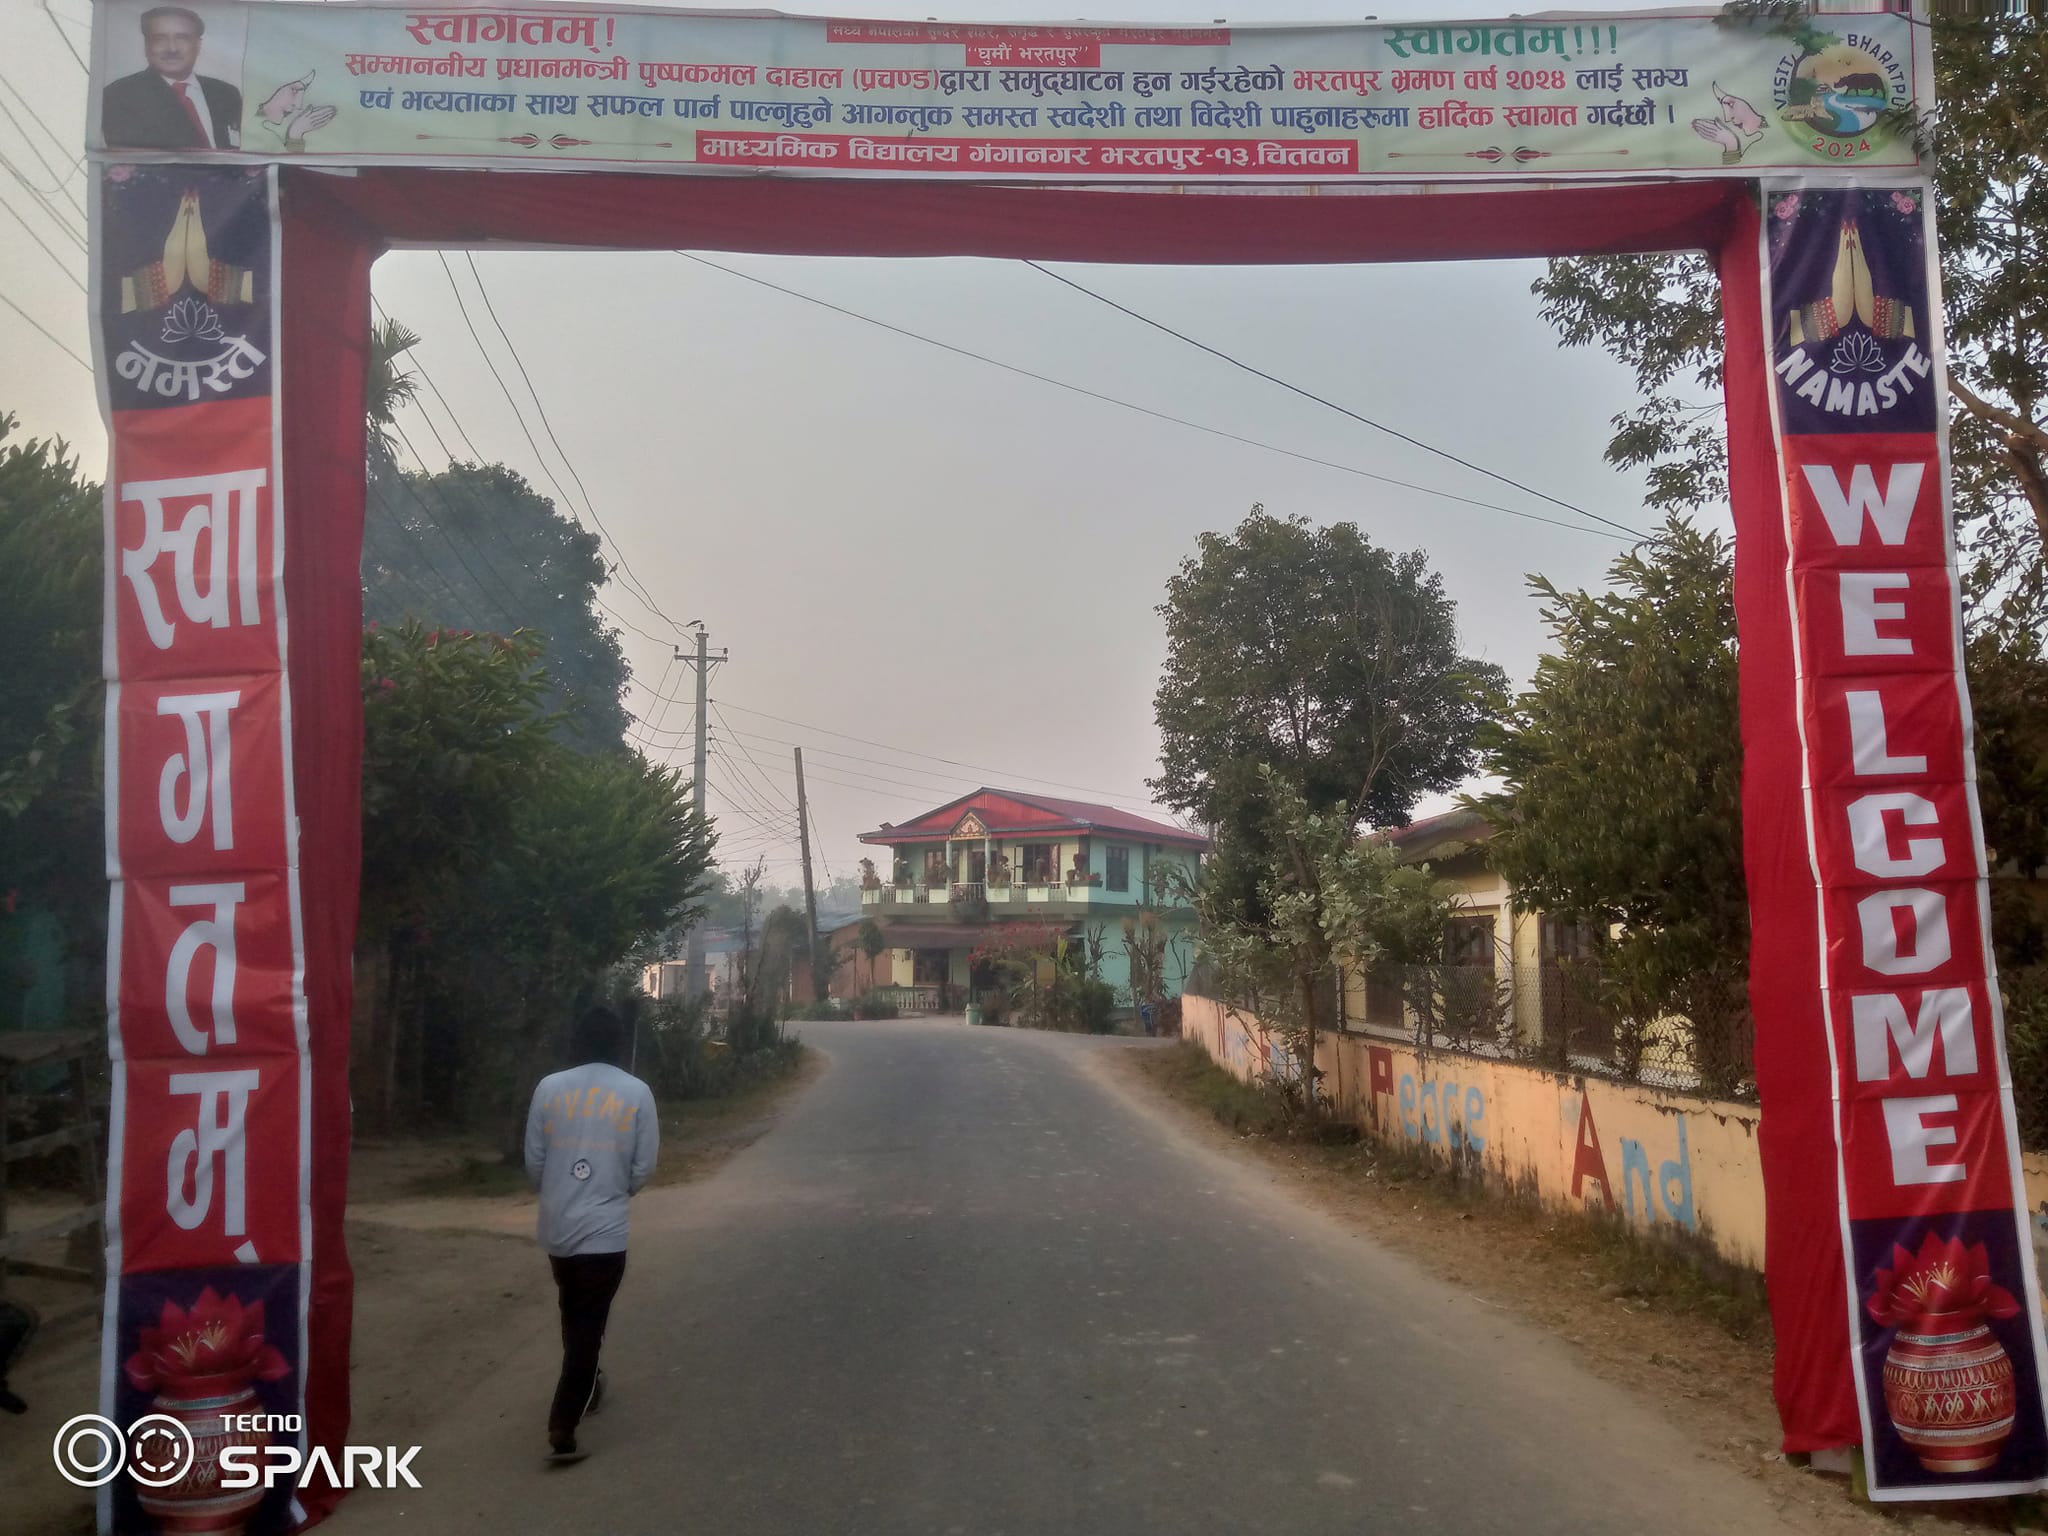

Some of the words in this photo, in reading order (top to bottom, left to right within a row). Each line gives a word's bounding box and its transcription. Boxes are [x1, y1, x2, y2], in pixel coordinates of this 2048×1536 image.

[406, 14, 614, 53] स्वागतम्!
[1384, 25, 1617, 61] स्वागतम्!!!
[345, 51, 487, 77] सम्माननीय
[496, 55, 630, 81] प्रधानमन्त्री
[639, 63, 757, 88] पुष्पकमल
[766, 67, 843, 89] दाहाल
[1133, 72, 1172, 98] हुन
[1180, 64, 1284, 95] गईरहेको
[1294, 71, 1382, 96] भरतपुर
[1391, 70, 1455, 94] भ्रमण
[1463, 65, 1497, 91] वर्ष
[1506, 70, 1566, 91] २०२४
[1575, 63, 1624, 93] लाई
[1632, 68, 1688, 91] सभ्य
[1773, 55, 1794, 111] VISIT
[360, 87, 394, 110] एवं
[402, 91, 517, 114] भव्यताका
[526, 95, 579, 116] साथ
[587, 95, 664, 119] सफल
[674, 94, 721, 119] पार्न
[842, 103, 954, 132] आगन्तुक
[962, 106, 1038, 129] समस्त
[1047, 101, 1126, 129] स्वदेशी
[1135, 106, 1182, 128] तथा
[1191, 100, 1262, 130] विदेशी
[1418, 100, 1494, 130] हार्दिक
[1502, 105, 1578, 128] स्वागत
[703, 135, 840, 159] माध्यमिक
[849, 137, 960, 163] विद्यालय
[969, 143, 1092, 166] गंगानगर
[1812, 137, 1871, 158] 2024
[1775, 343, 1932, 417] NAMASTE
[1801, 462, 1978, 1187] WELCOME
[1368, 1046, 1486, 1152] Peace
[1571, 1088, 1695, 1231] And
